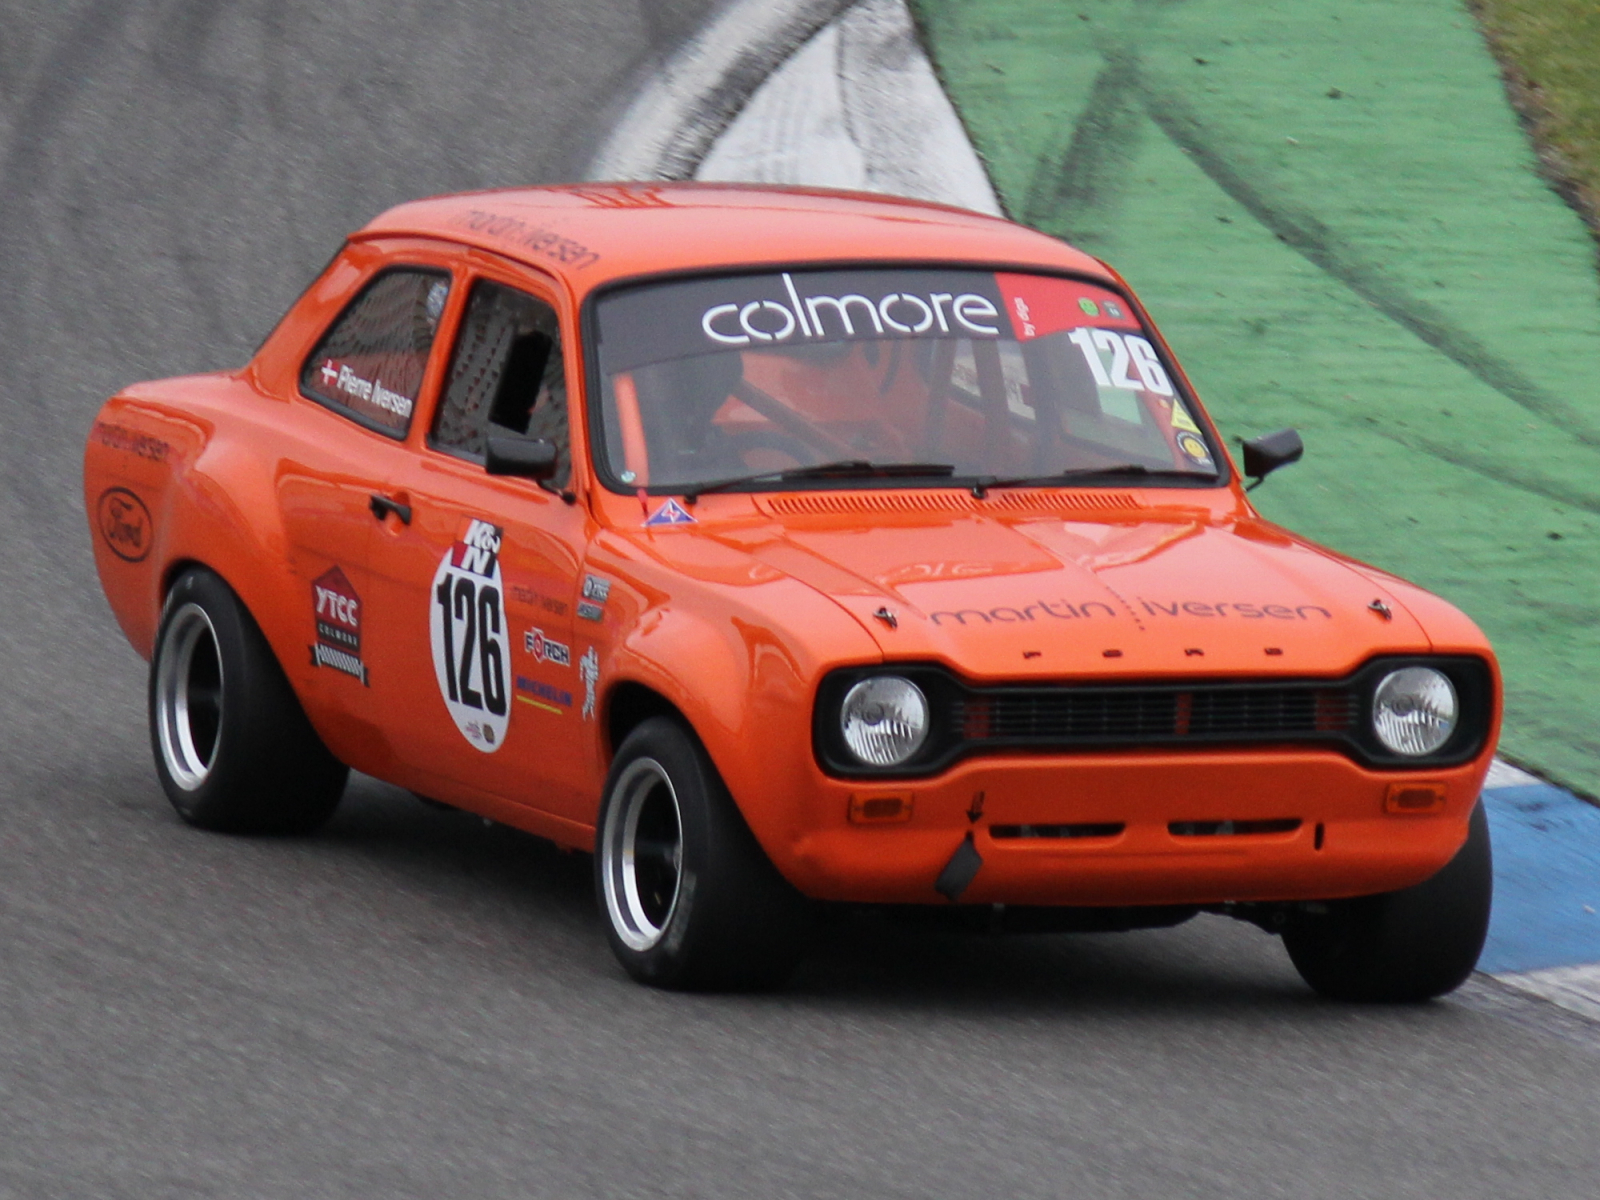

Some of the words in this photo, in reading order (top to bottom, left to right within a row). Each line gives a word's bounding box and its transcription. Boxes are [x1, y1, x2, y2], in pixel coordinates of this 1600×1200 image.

[701, 272, 1000, 343] colmore
[336, 364, 373, 401] Pierre
[371, 379, 413, 418] Iversen
[1067, 327, 1173, 396] 126
[315, 585, 358, 627] YTCC
[931, 599, 1116, 626] martin
[1136, 597, 1333, 621] iversen
[437, 571, 507, 716] 126
